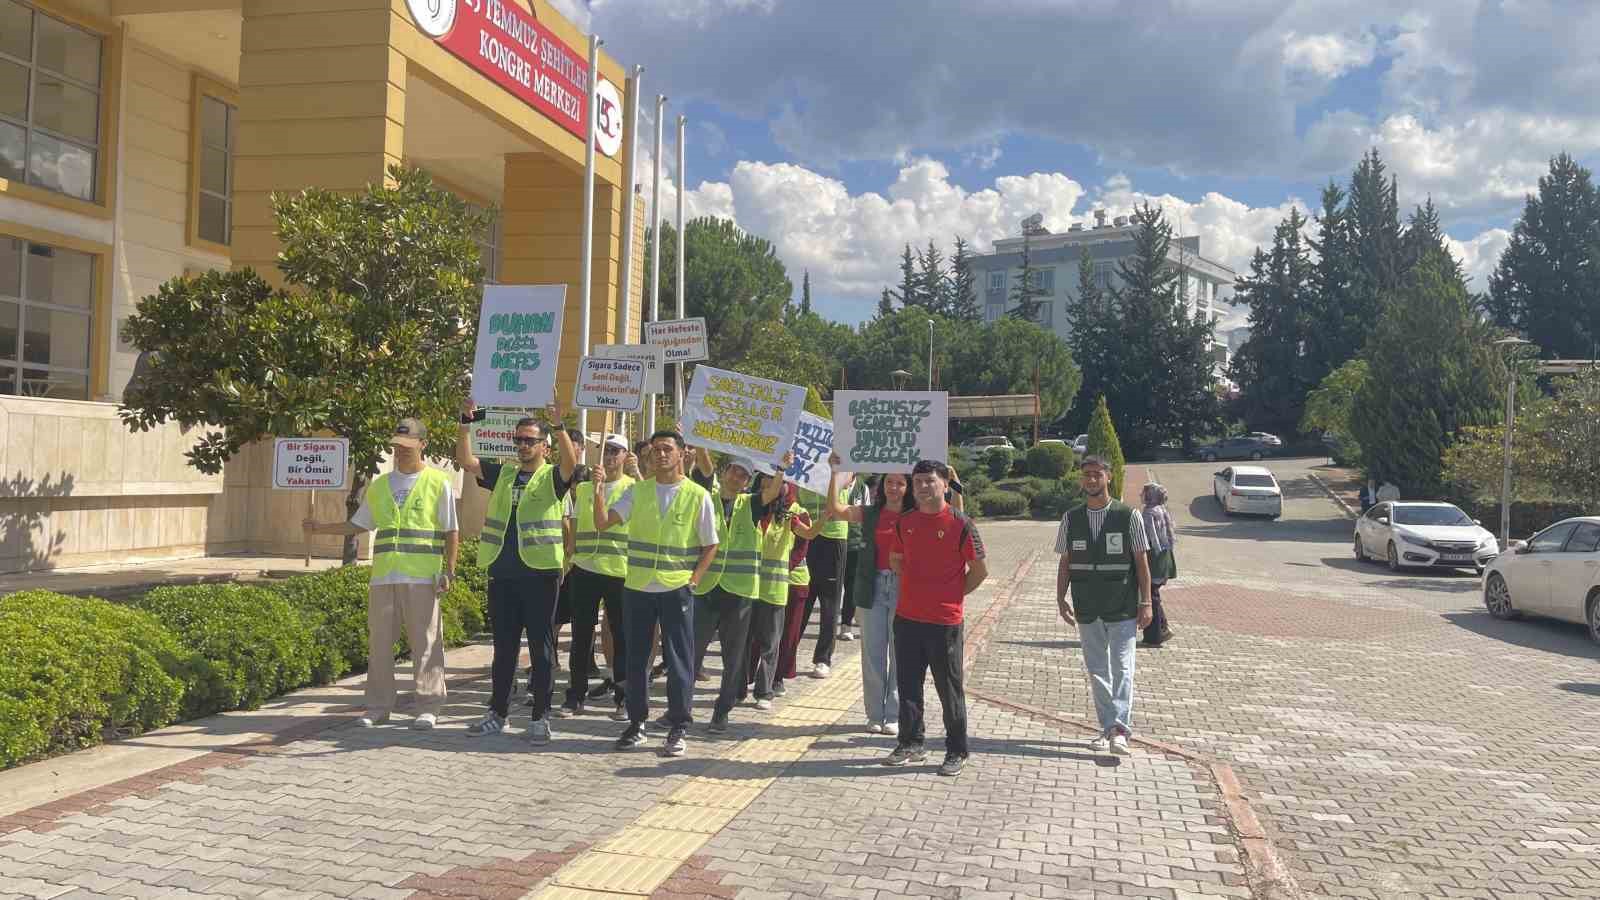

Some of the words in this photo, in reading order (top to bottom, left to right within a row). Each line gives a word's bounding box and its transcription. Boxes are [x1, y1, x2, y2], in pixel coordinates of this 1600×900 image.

[485, 0, 538, 55] TEMMUZ
[540, 36, 589, 95] ŞEHİTLER
[479, 29, 531, 88] KONGRE
[533, 68, 581, 122] MERKEZİ
[488, 312, 555, 335] DUMAN
[667, 323, 700, 334] Nefeste
[490, 351, 541, 371] NEFES
[588, 360, 613, 372] Sigara
[613, 361, 641, 372] Sadece
[498, 370, 528, 393] AL
[592, 372, 609, 382] Seni
[287, 442, 301, 452] Bir
[303, 442, 336, 453] Sigara
[856, 430, 917, 448] UMUTLU
[296, 453, 326, 464] Değil,
[849, 447, 921, 464] GELECEK
[288, 465, 303, 474] Bir
[304, 464, 333, 474] Ömür
